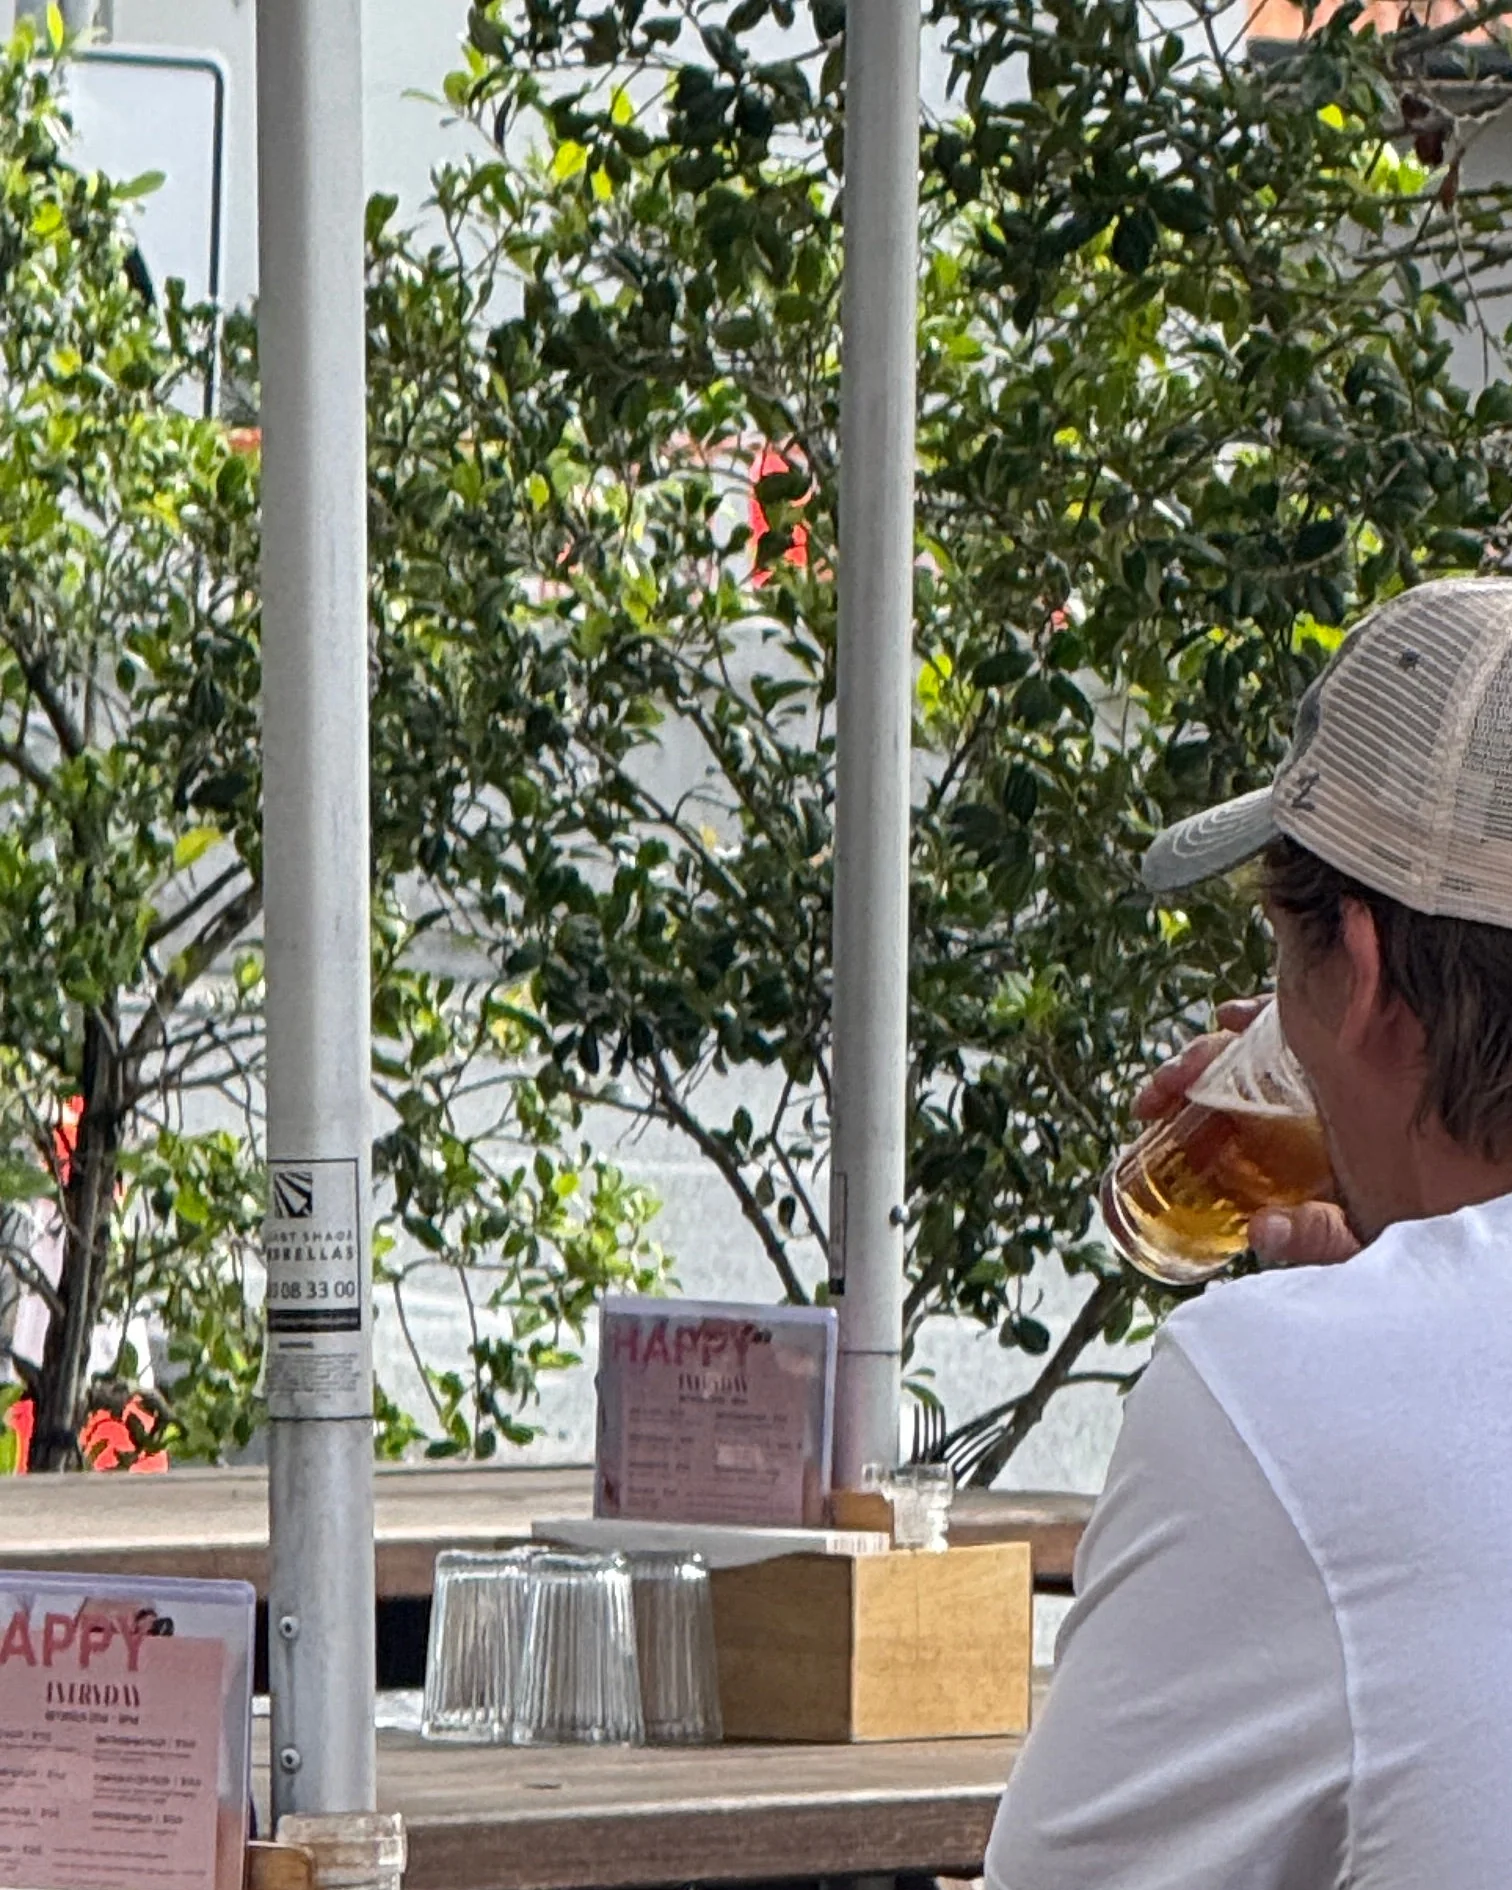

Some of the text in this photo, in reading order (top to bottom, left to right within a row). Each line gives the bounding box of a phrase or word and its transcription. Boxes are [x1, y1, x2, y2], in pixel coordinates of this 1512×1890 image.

[306, 1280, 329, 1299] 33
[334, 1280, 356, 1299] 00
[612, 1318, 757, 1368] HAPPY
[0, 1610, 146, 1672] APPY
